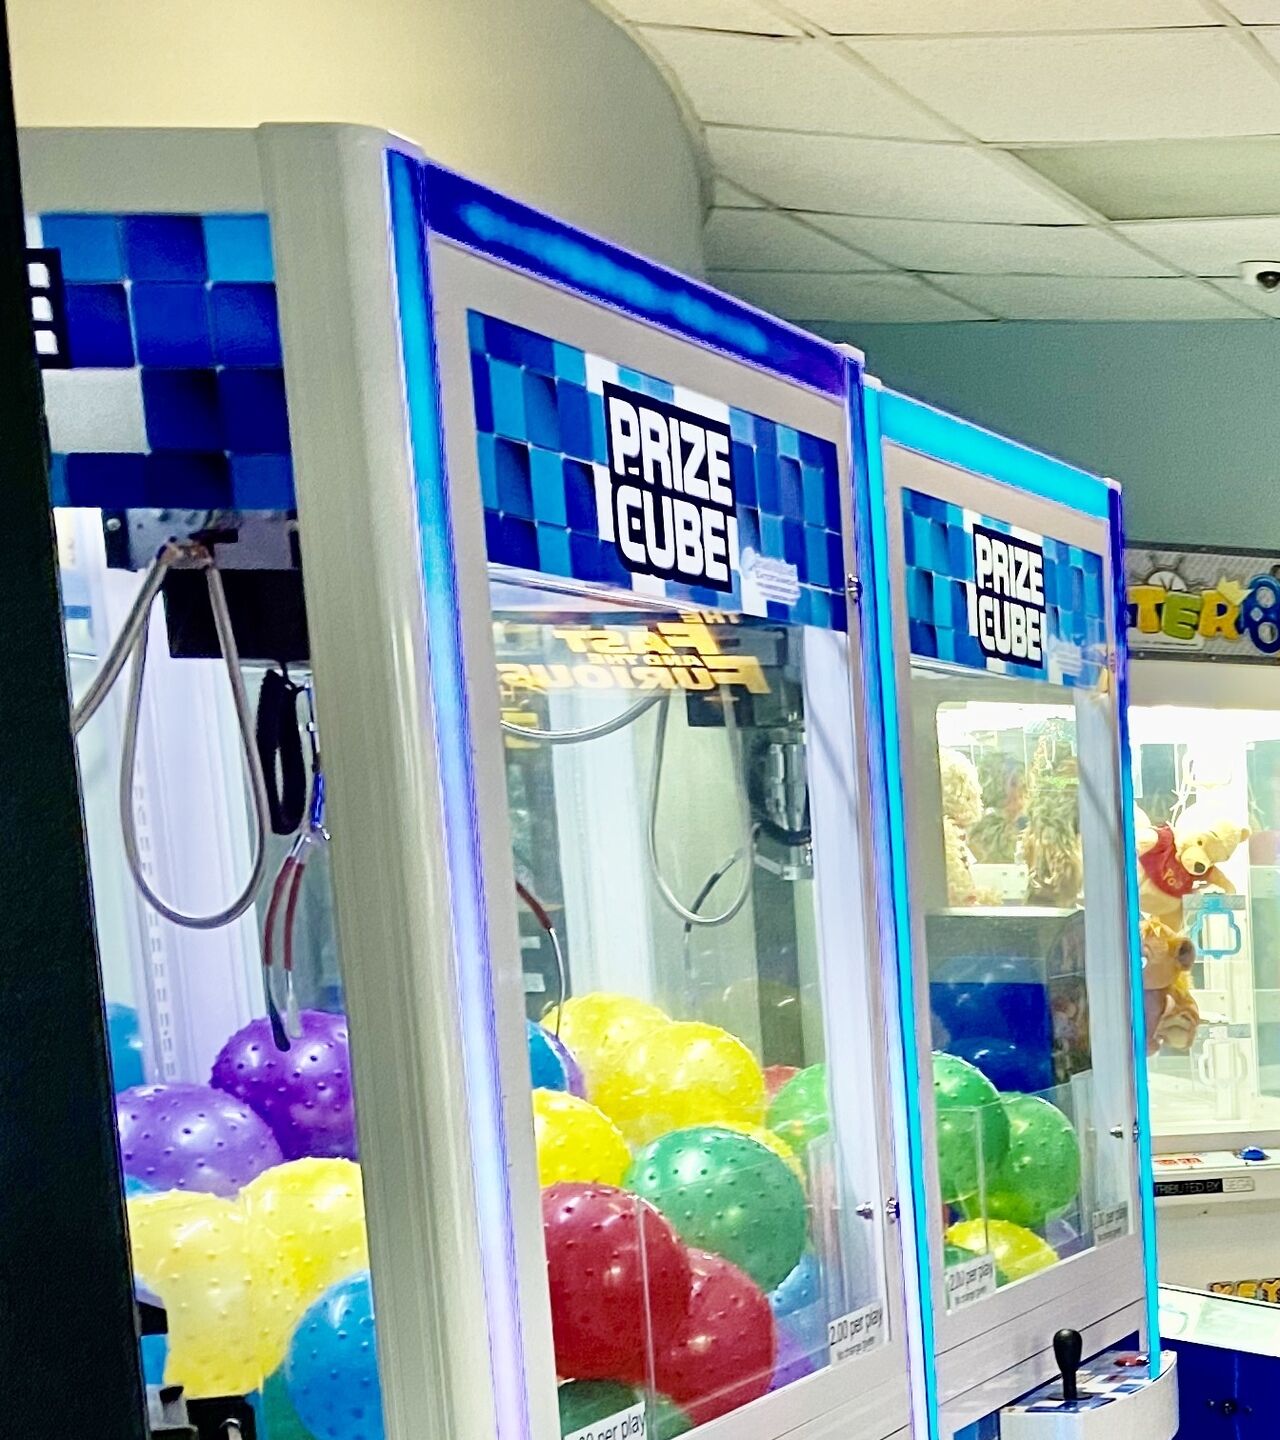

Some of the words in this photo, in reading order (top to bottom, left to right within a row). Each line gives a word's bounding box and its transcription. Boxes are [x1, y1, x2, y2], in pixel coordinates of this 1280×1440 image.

[608, 396, 733, 507] PRIZE
[616, 484, 730, 582] CUBE
[974, 533, 1045, 607] PRIZE
[978, 594, 1042, 662] CUBE
[1206, 1181, 1220, 1193] BY
[1224, 1178, 1253, 1190] SEGA
[850, 1315, 864, 1341] per
[865, 1307, 883, 1334] play
